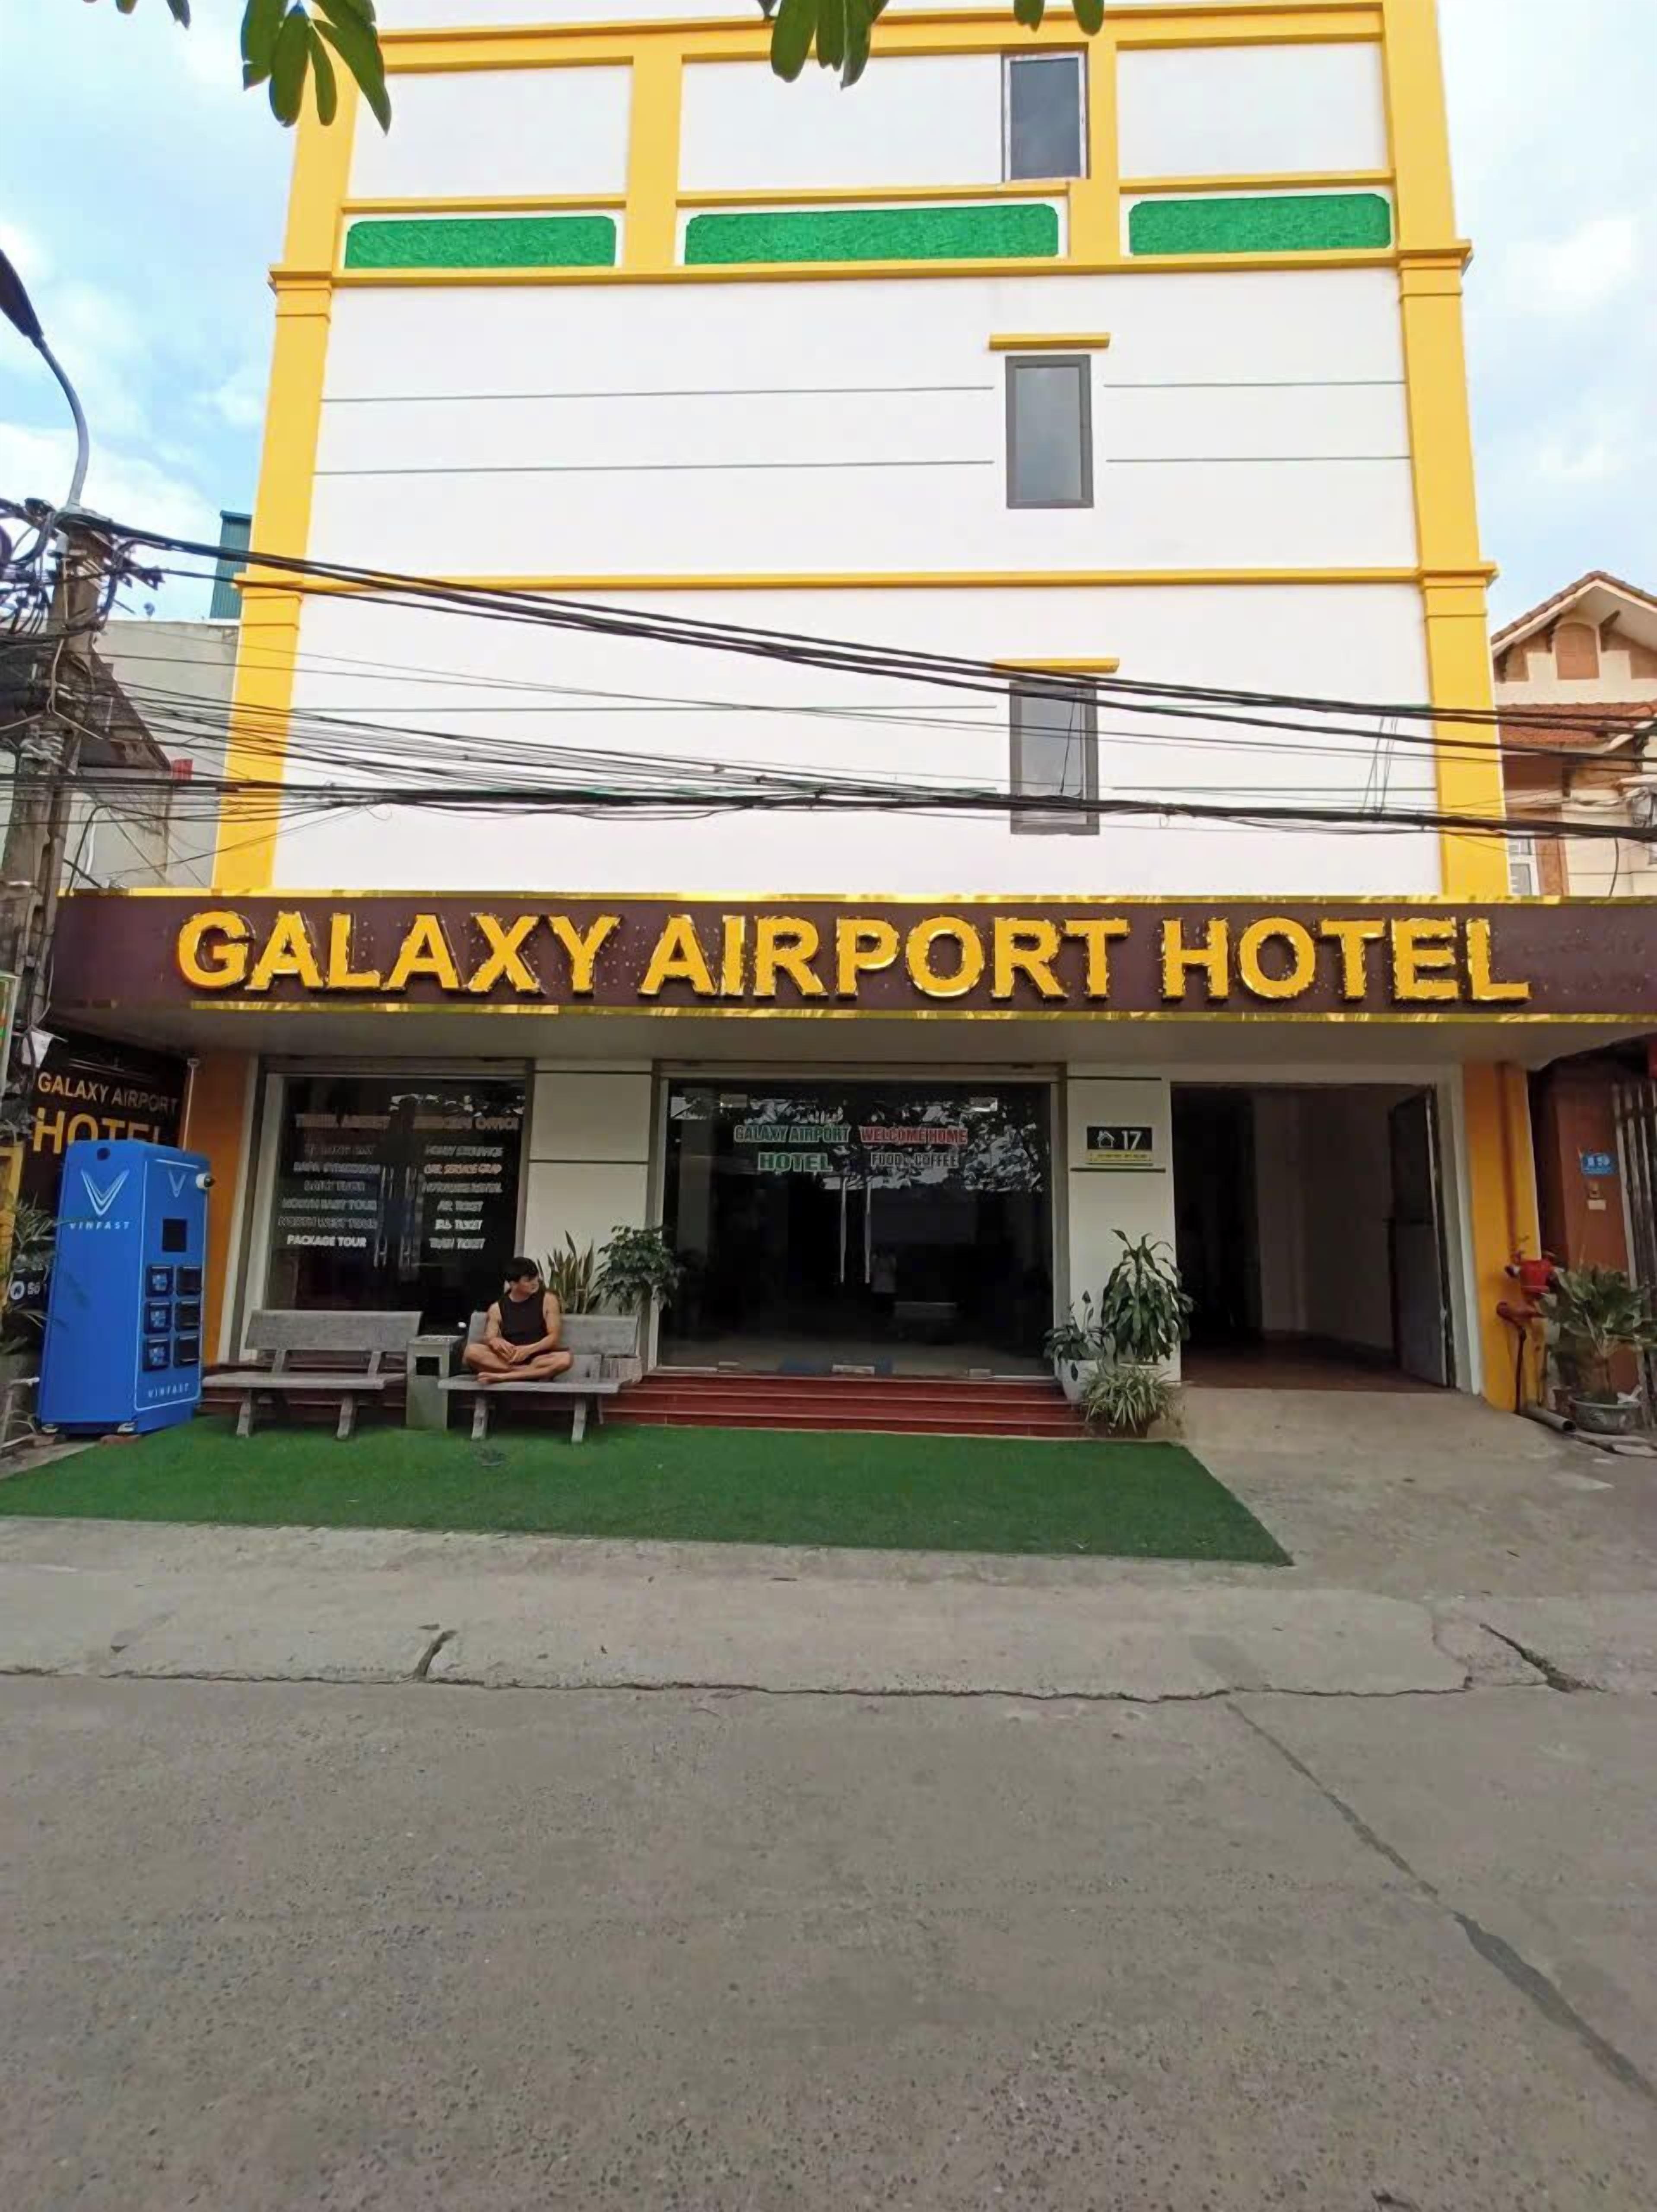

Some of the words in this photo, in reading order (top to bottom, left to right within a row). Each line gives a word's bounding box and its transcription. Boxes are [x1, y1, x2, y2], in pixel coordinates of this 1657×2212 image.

[178, 911, 619, 996] GALAXY
[637, 914, 1129, 997] AIRPORT
[1161, 917, 1530, 1001] HOTEL
[38, 1072, 109, 1103] GALAXY
[111, 1087, 178, 1115] AIRPORT
[734, 1125, 788, 1142] GALAXY
[788, 1125, 851, 1143] AIRPORT
[859, 1126, 926, 1144] WELCOME
[927, 1127, 968, 1144] HOME
[1121, 1130, 1142, 1150] 17
[758, 1152, 833, 1172] HOTEL
[70, 1221, 130, 1230] VINFAST
[287, 1234, 335, 1246] PACKAGE
[337, 1236, 367, 1247] TOUR
